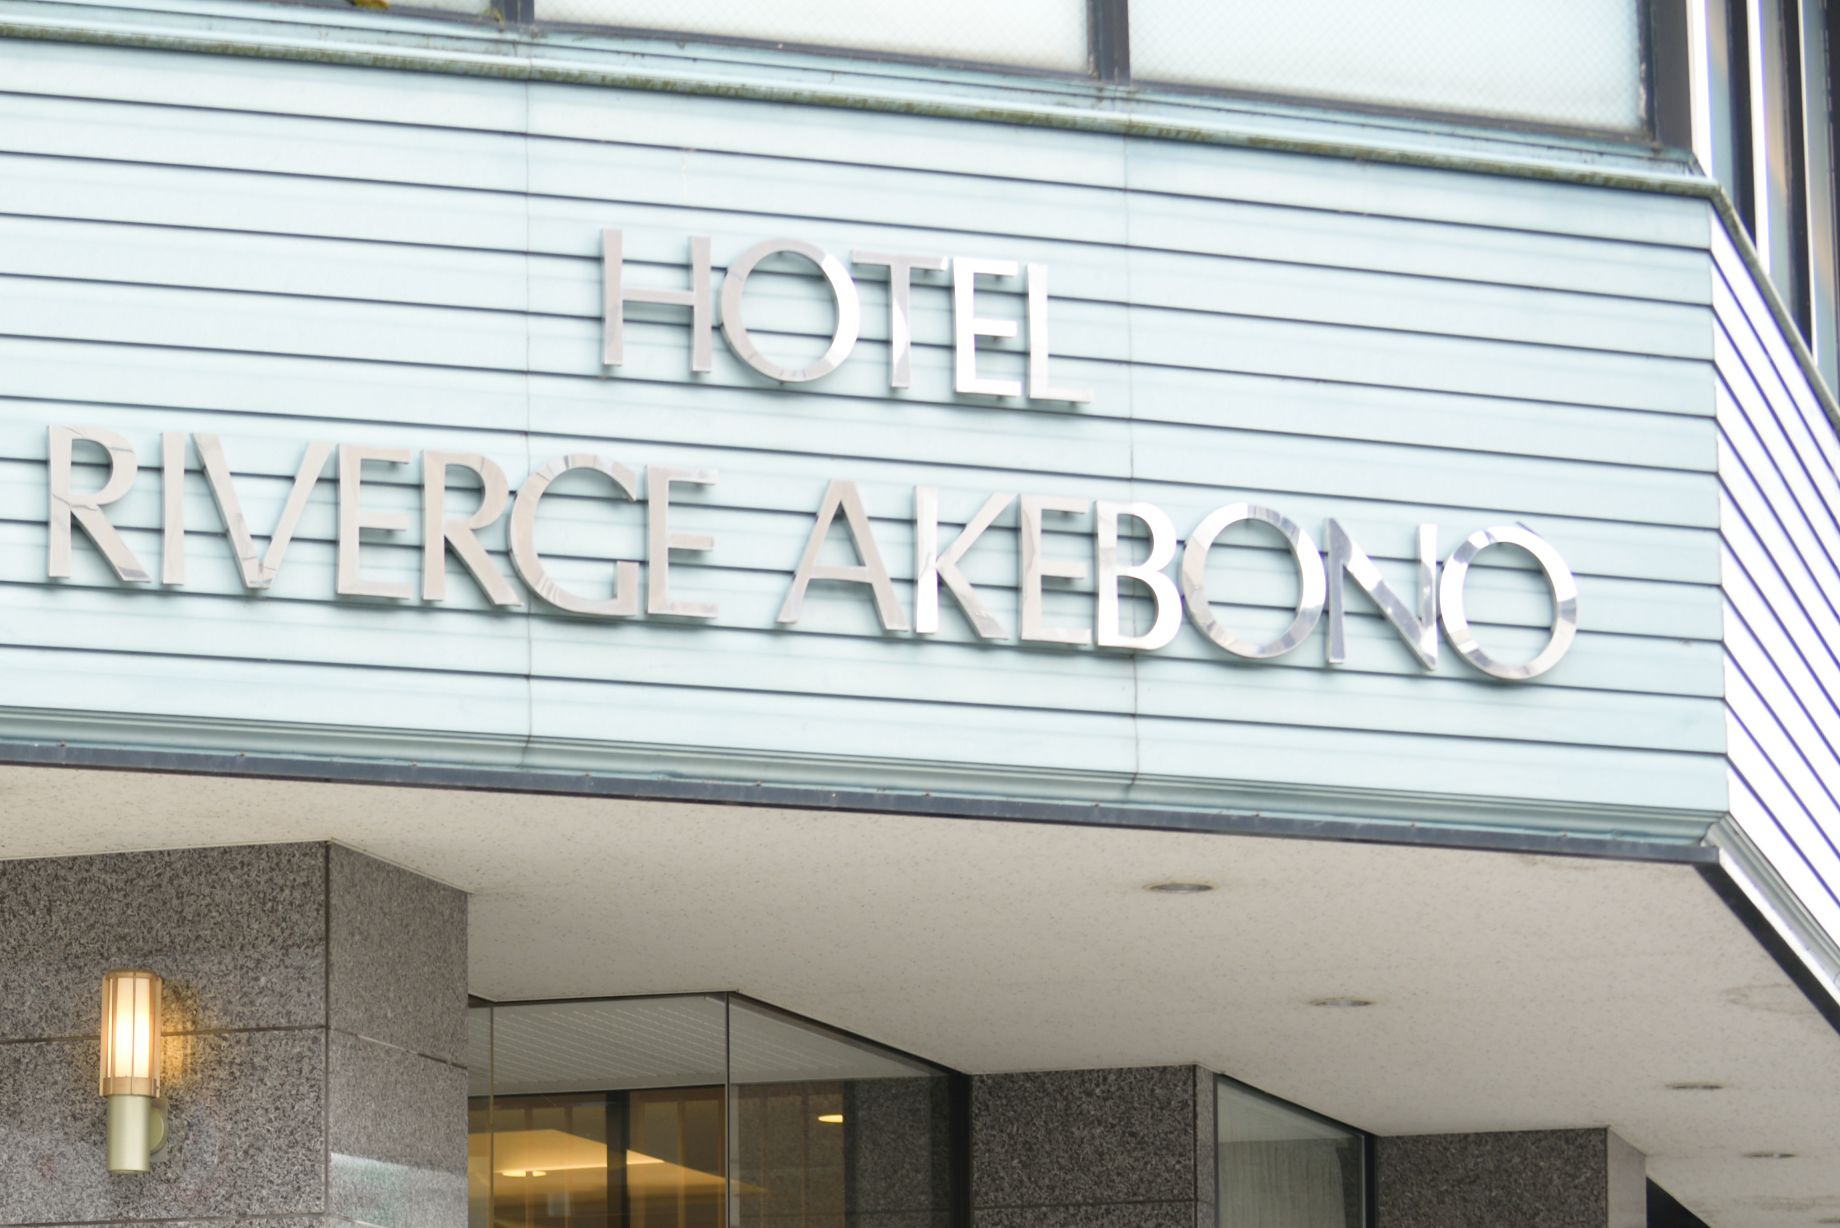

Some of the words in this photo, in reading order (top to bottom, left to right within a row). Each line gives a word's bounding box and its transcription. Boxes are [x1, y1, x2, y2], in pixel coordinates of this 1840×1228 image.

[599, 228, 1094, 405] HOTEL
[47, 424, 719, 620] RIVERGE
[773, 478, 1581, 682] AKEBONO
